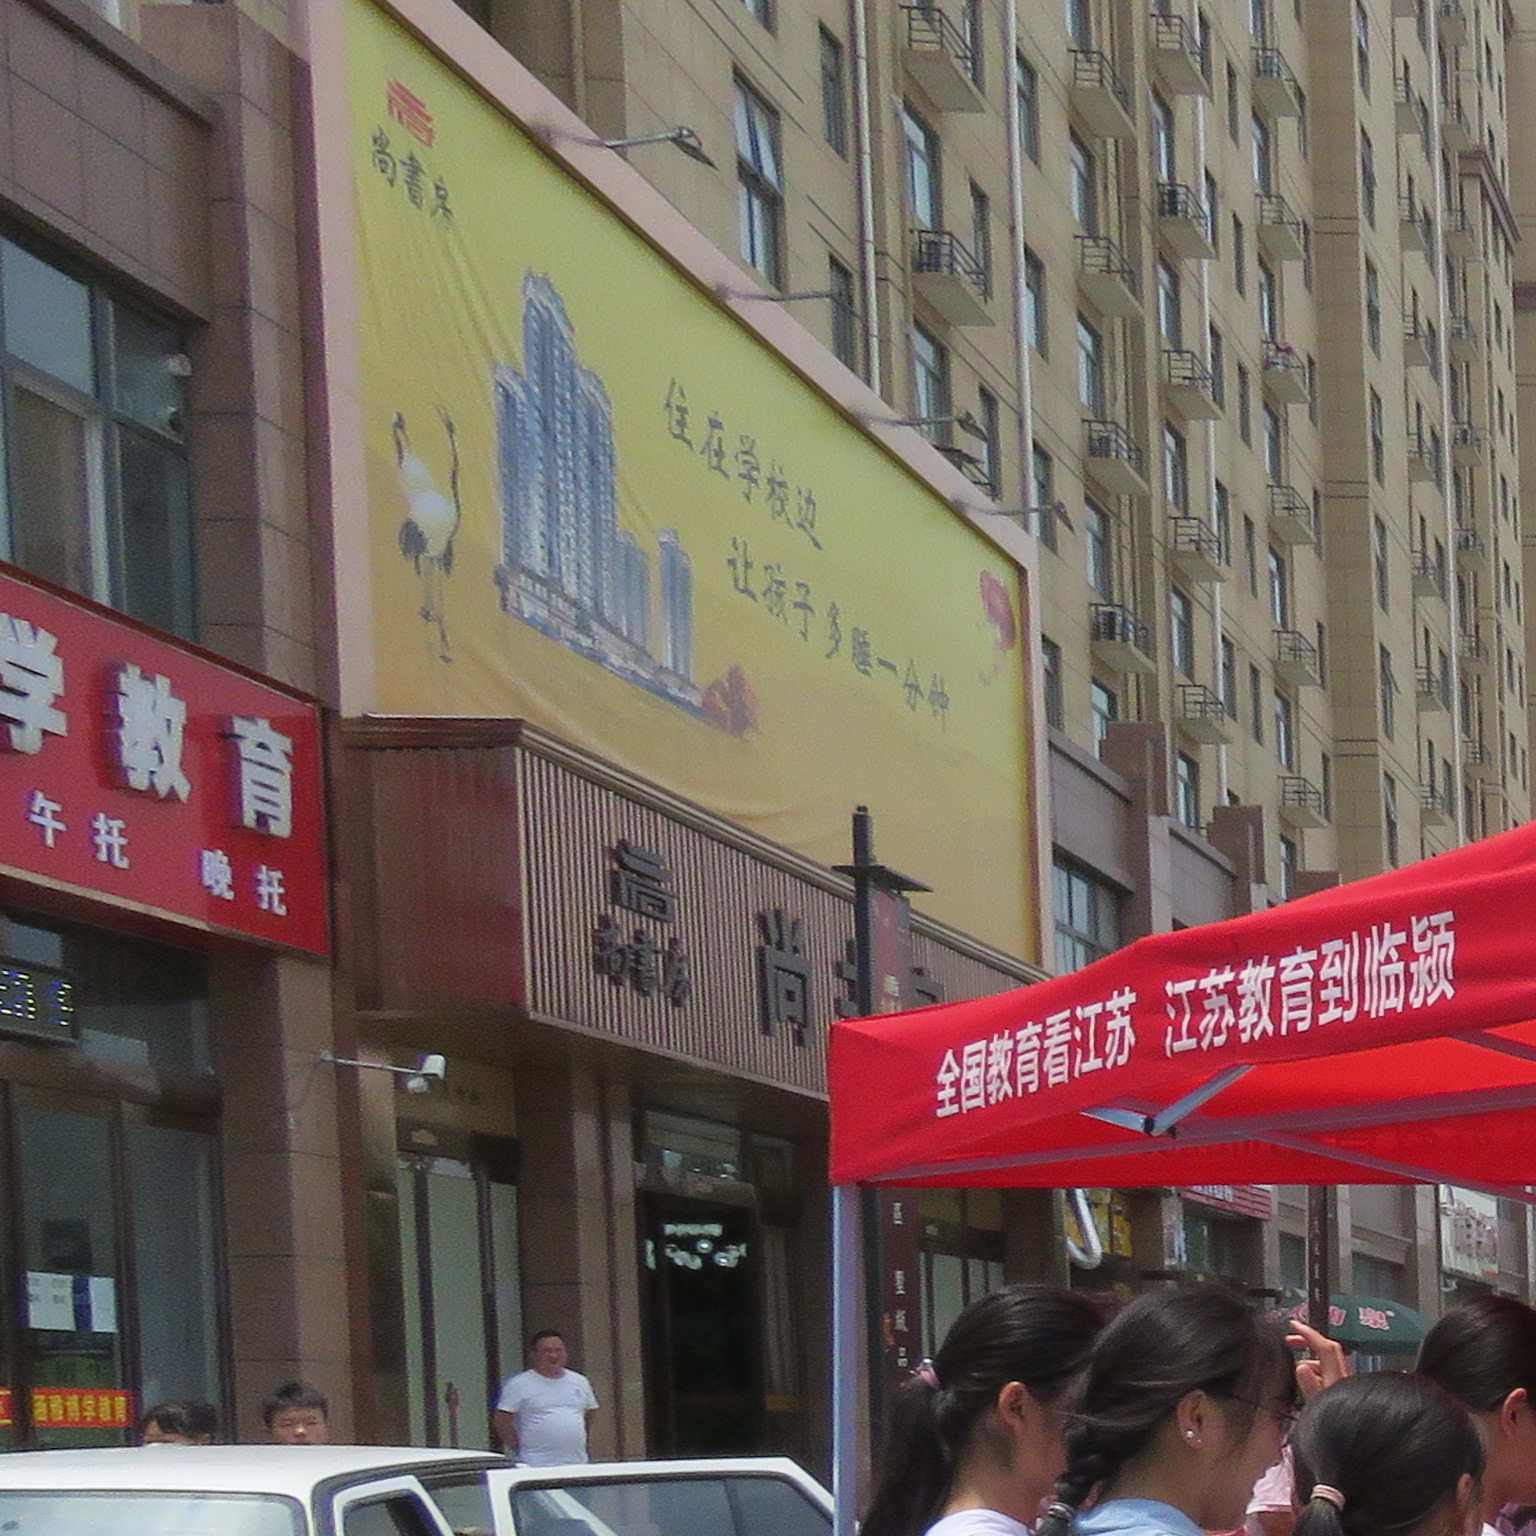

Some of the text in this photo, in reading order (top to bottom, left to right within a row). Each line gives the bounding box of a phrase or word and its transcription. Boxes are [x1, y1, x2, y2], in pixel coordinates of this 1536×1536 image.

[664, 377, 823, 550] 住在学校边
[27, 790, 288, 916] 午托 晚托
[935, 911, 1456, 1119] 全国教育看江苏 江苏教育到临颍
